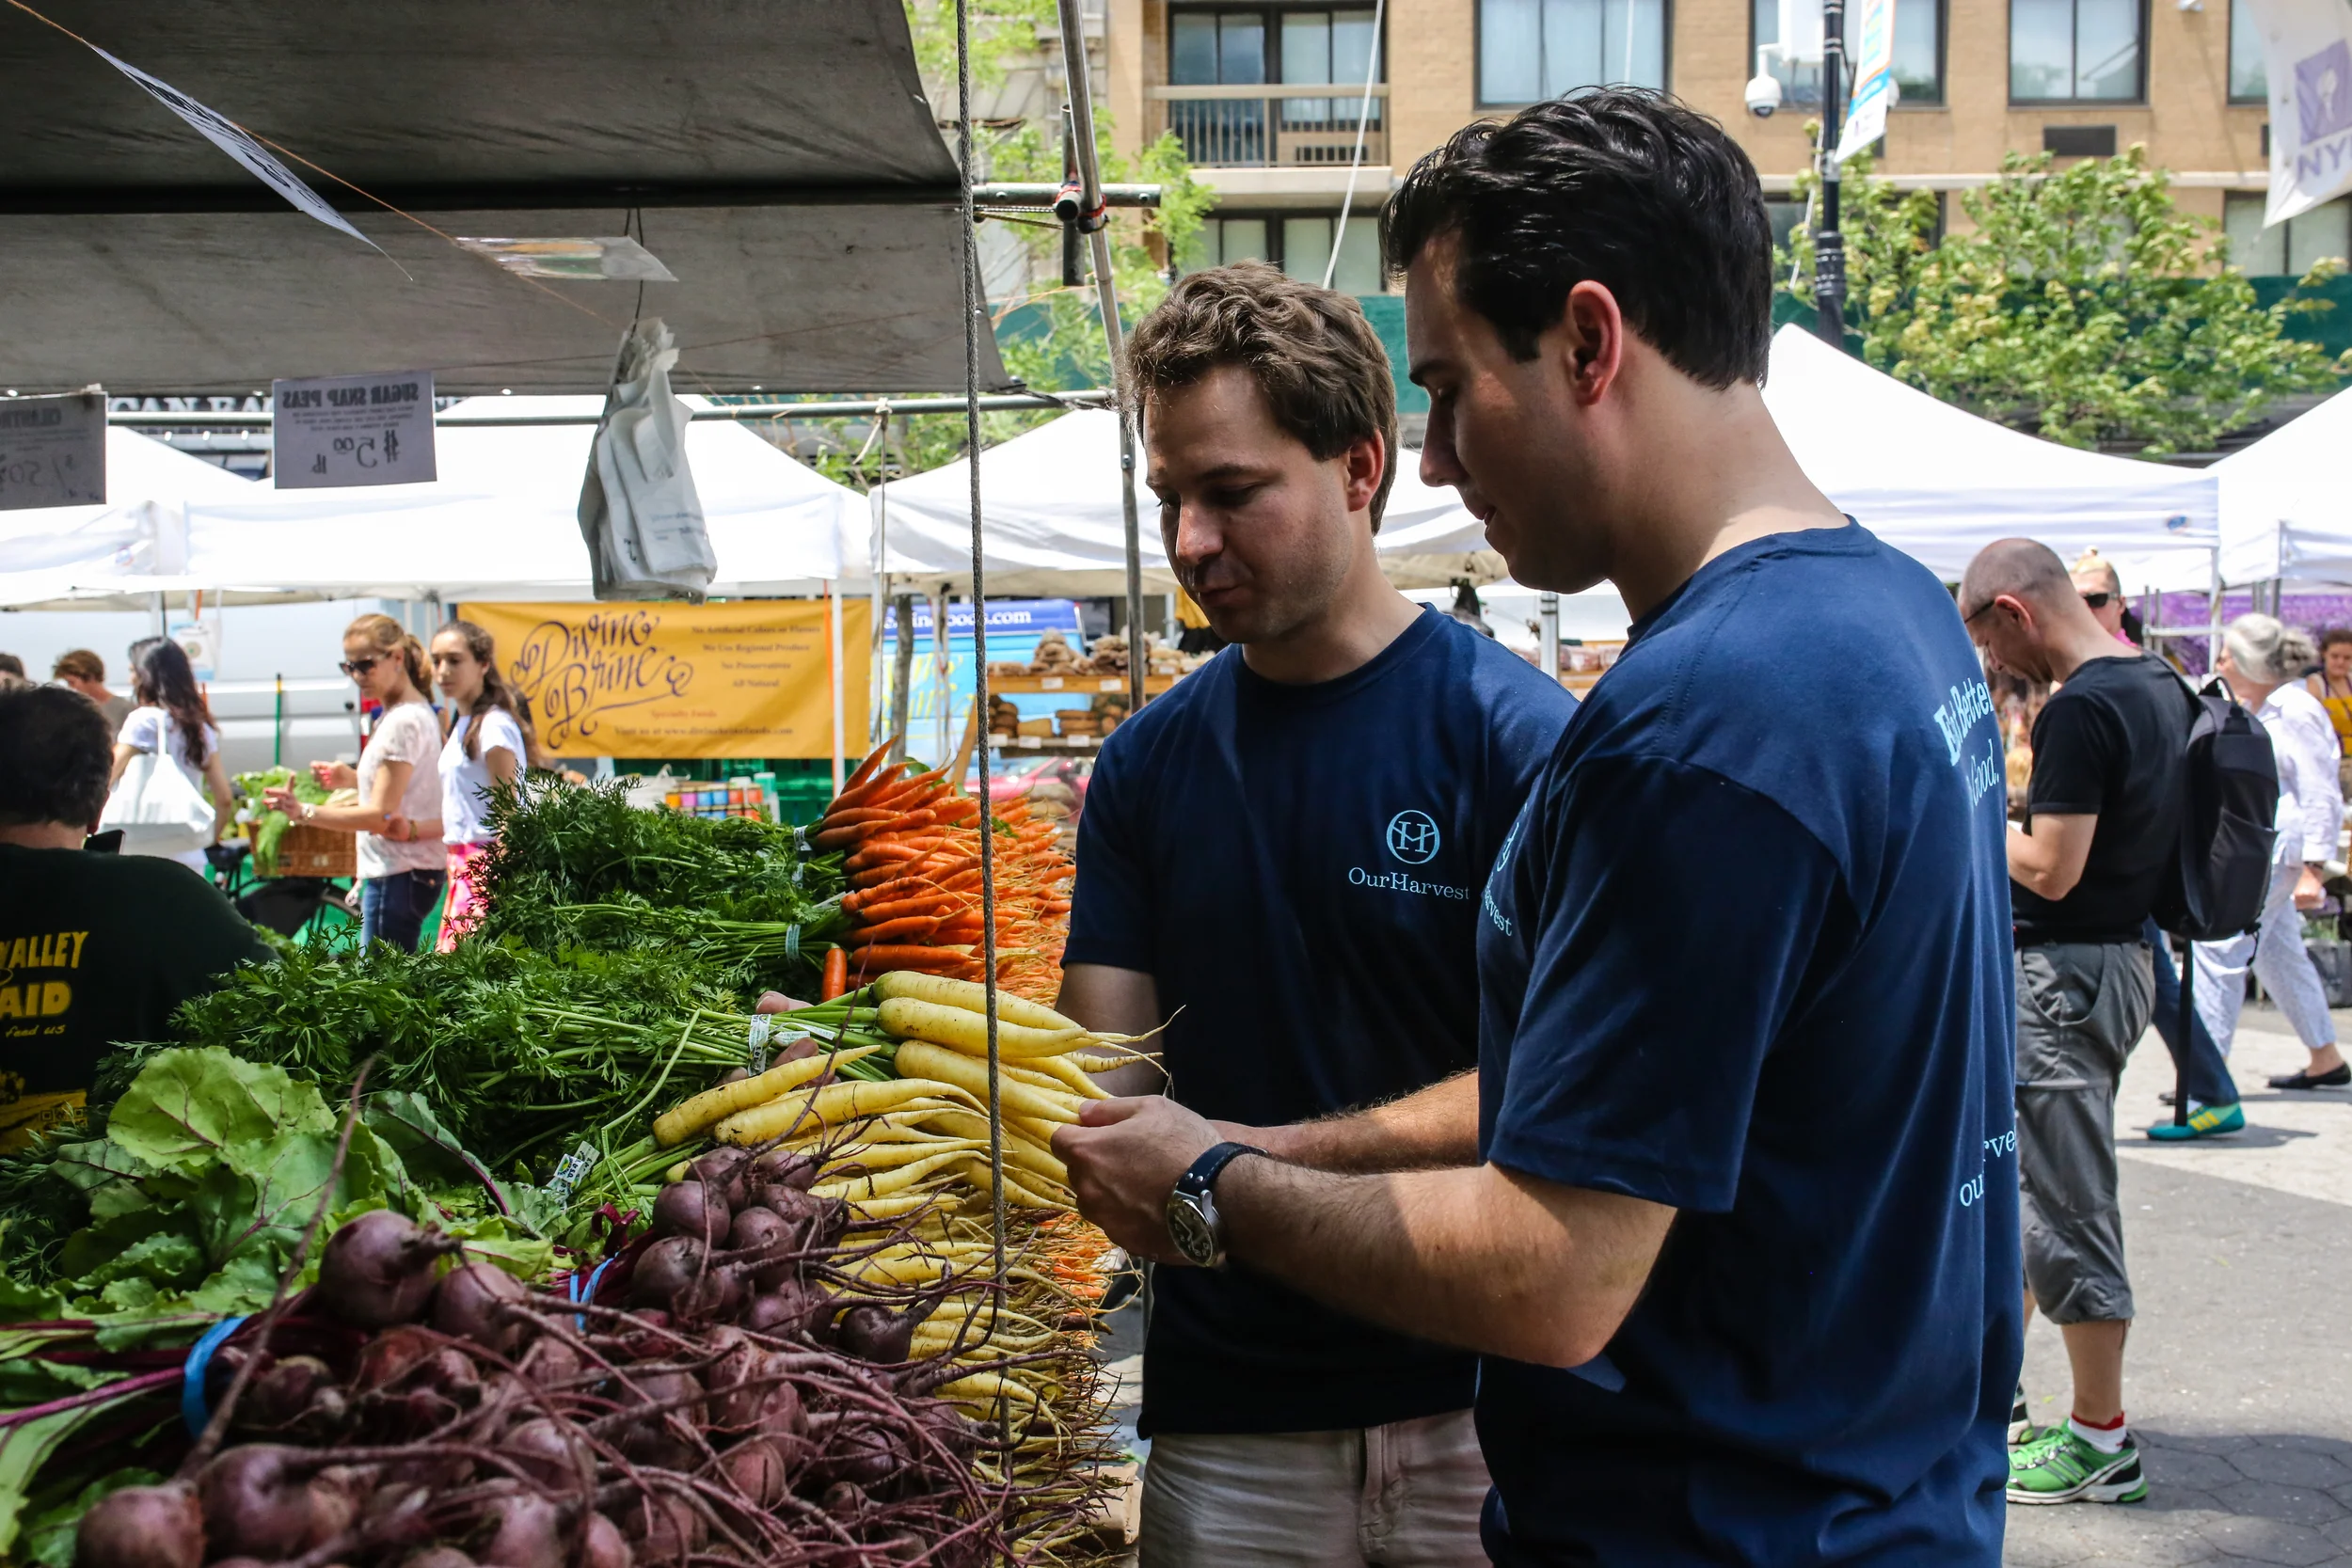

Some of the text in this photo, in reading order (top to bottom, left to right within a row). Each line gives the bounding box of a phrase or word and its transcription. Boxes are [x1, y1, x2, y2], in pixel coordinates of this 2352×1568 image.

[2296, 136, 2352, 183] NY
[510, 610, 660, 703] Divine
[1933, 677, 1994, 767] Eat Better
[1348, 866, 1470, 900] OurHarvest
[44, 1024, 66, 1036] us
